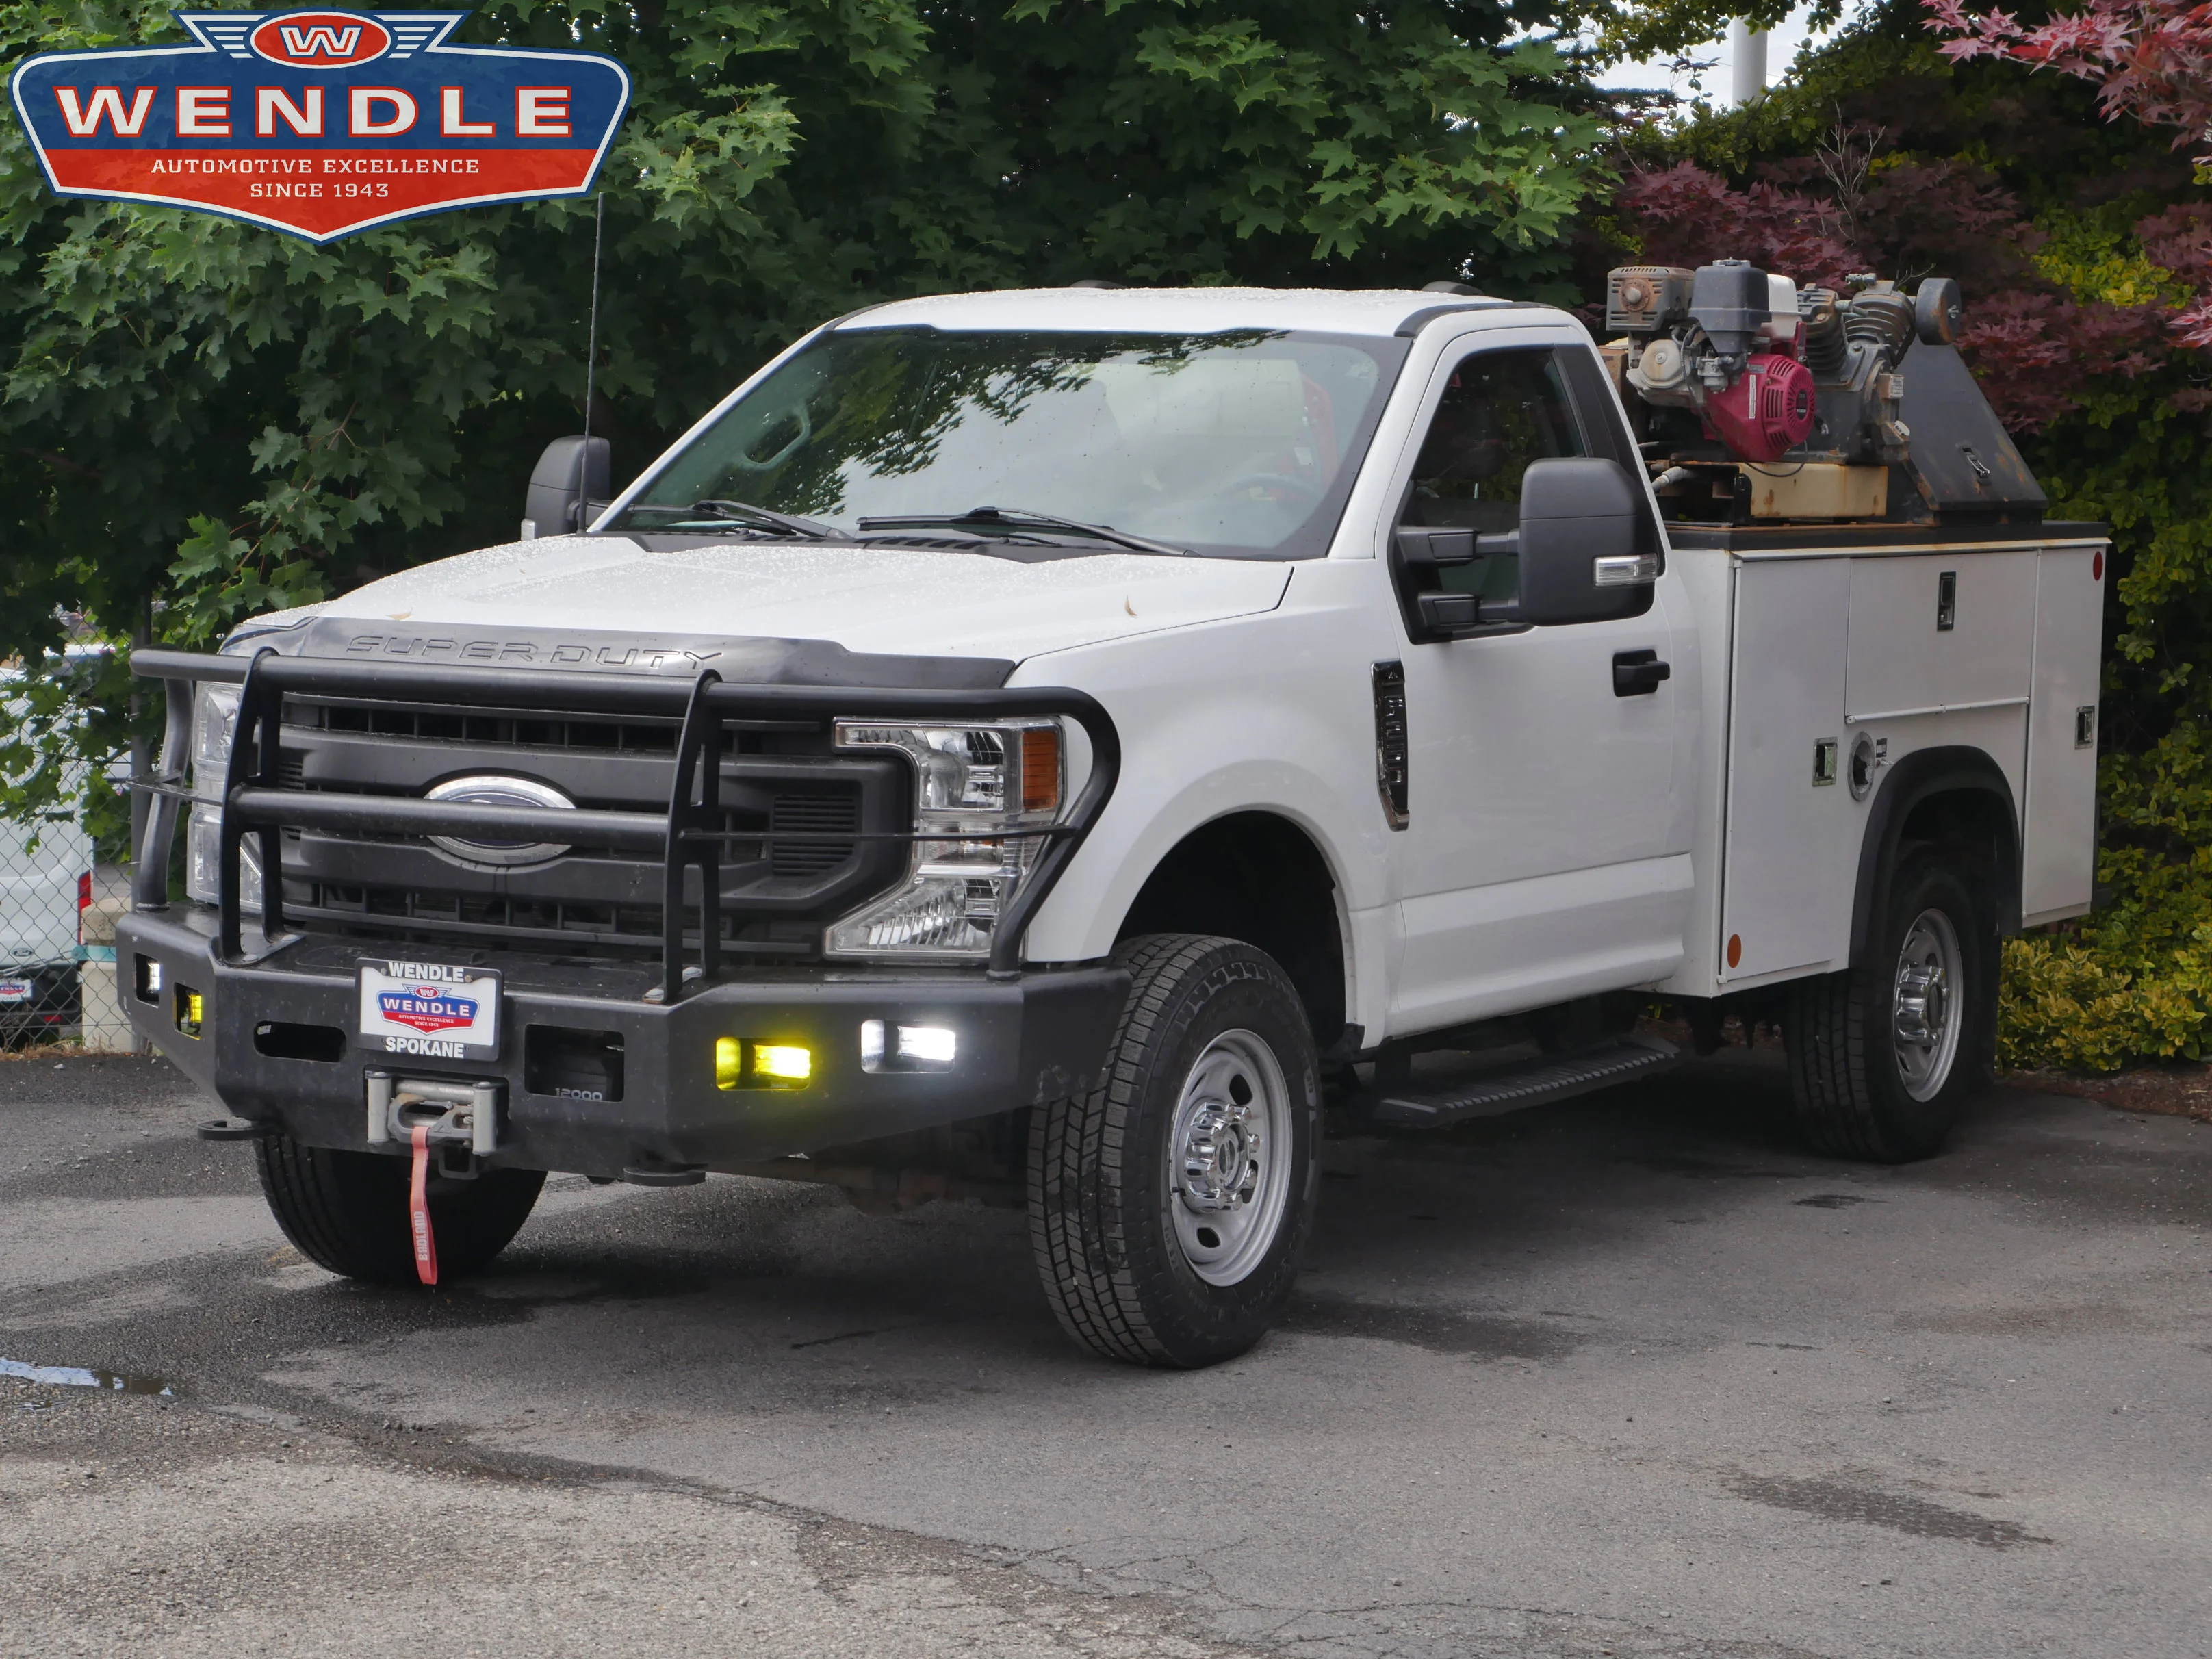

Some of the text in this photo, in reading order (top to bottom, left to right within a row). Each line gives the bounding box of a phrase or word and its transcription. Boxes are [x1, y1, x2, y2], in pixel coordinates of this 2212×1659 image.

[346, 634, 723, 671] SUPER DUTY
[388, 962, 464, 982] WENDLE
[383, 998, 470, 1016] WENDLE
[385, 1036, 464, 1058] SPOKANE
[413, 1211, 428, 1261] BADLAND
